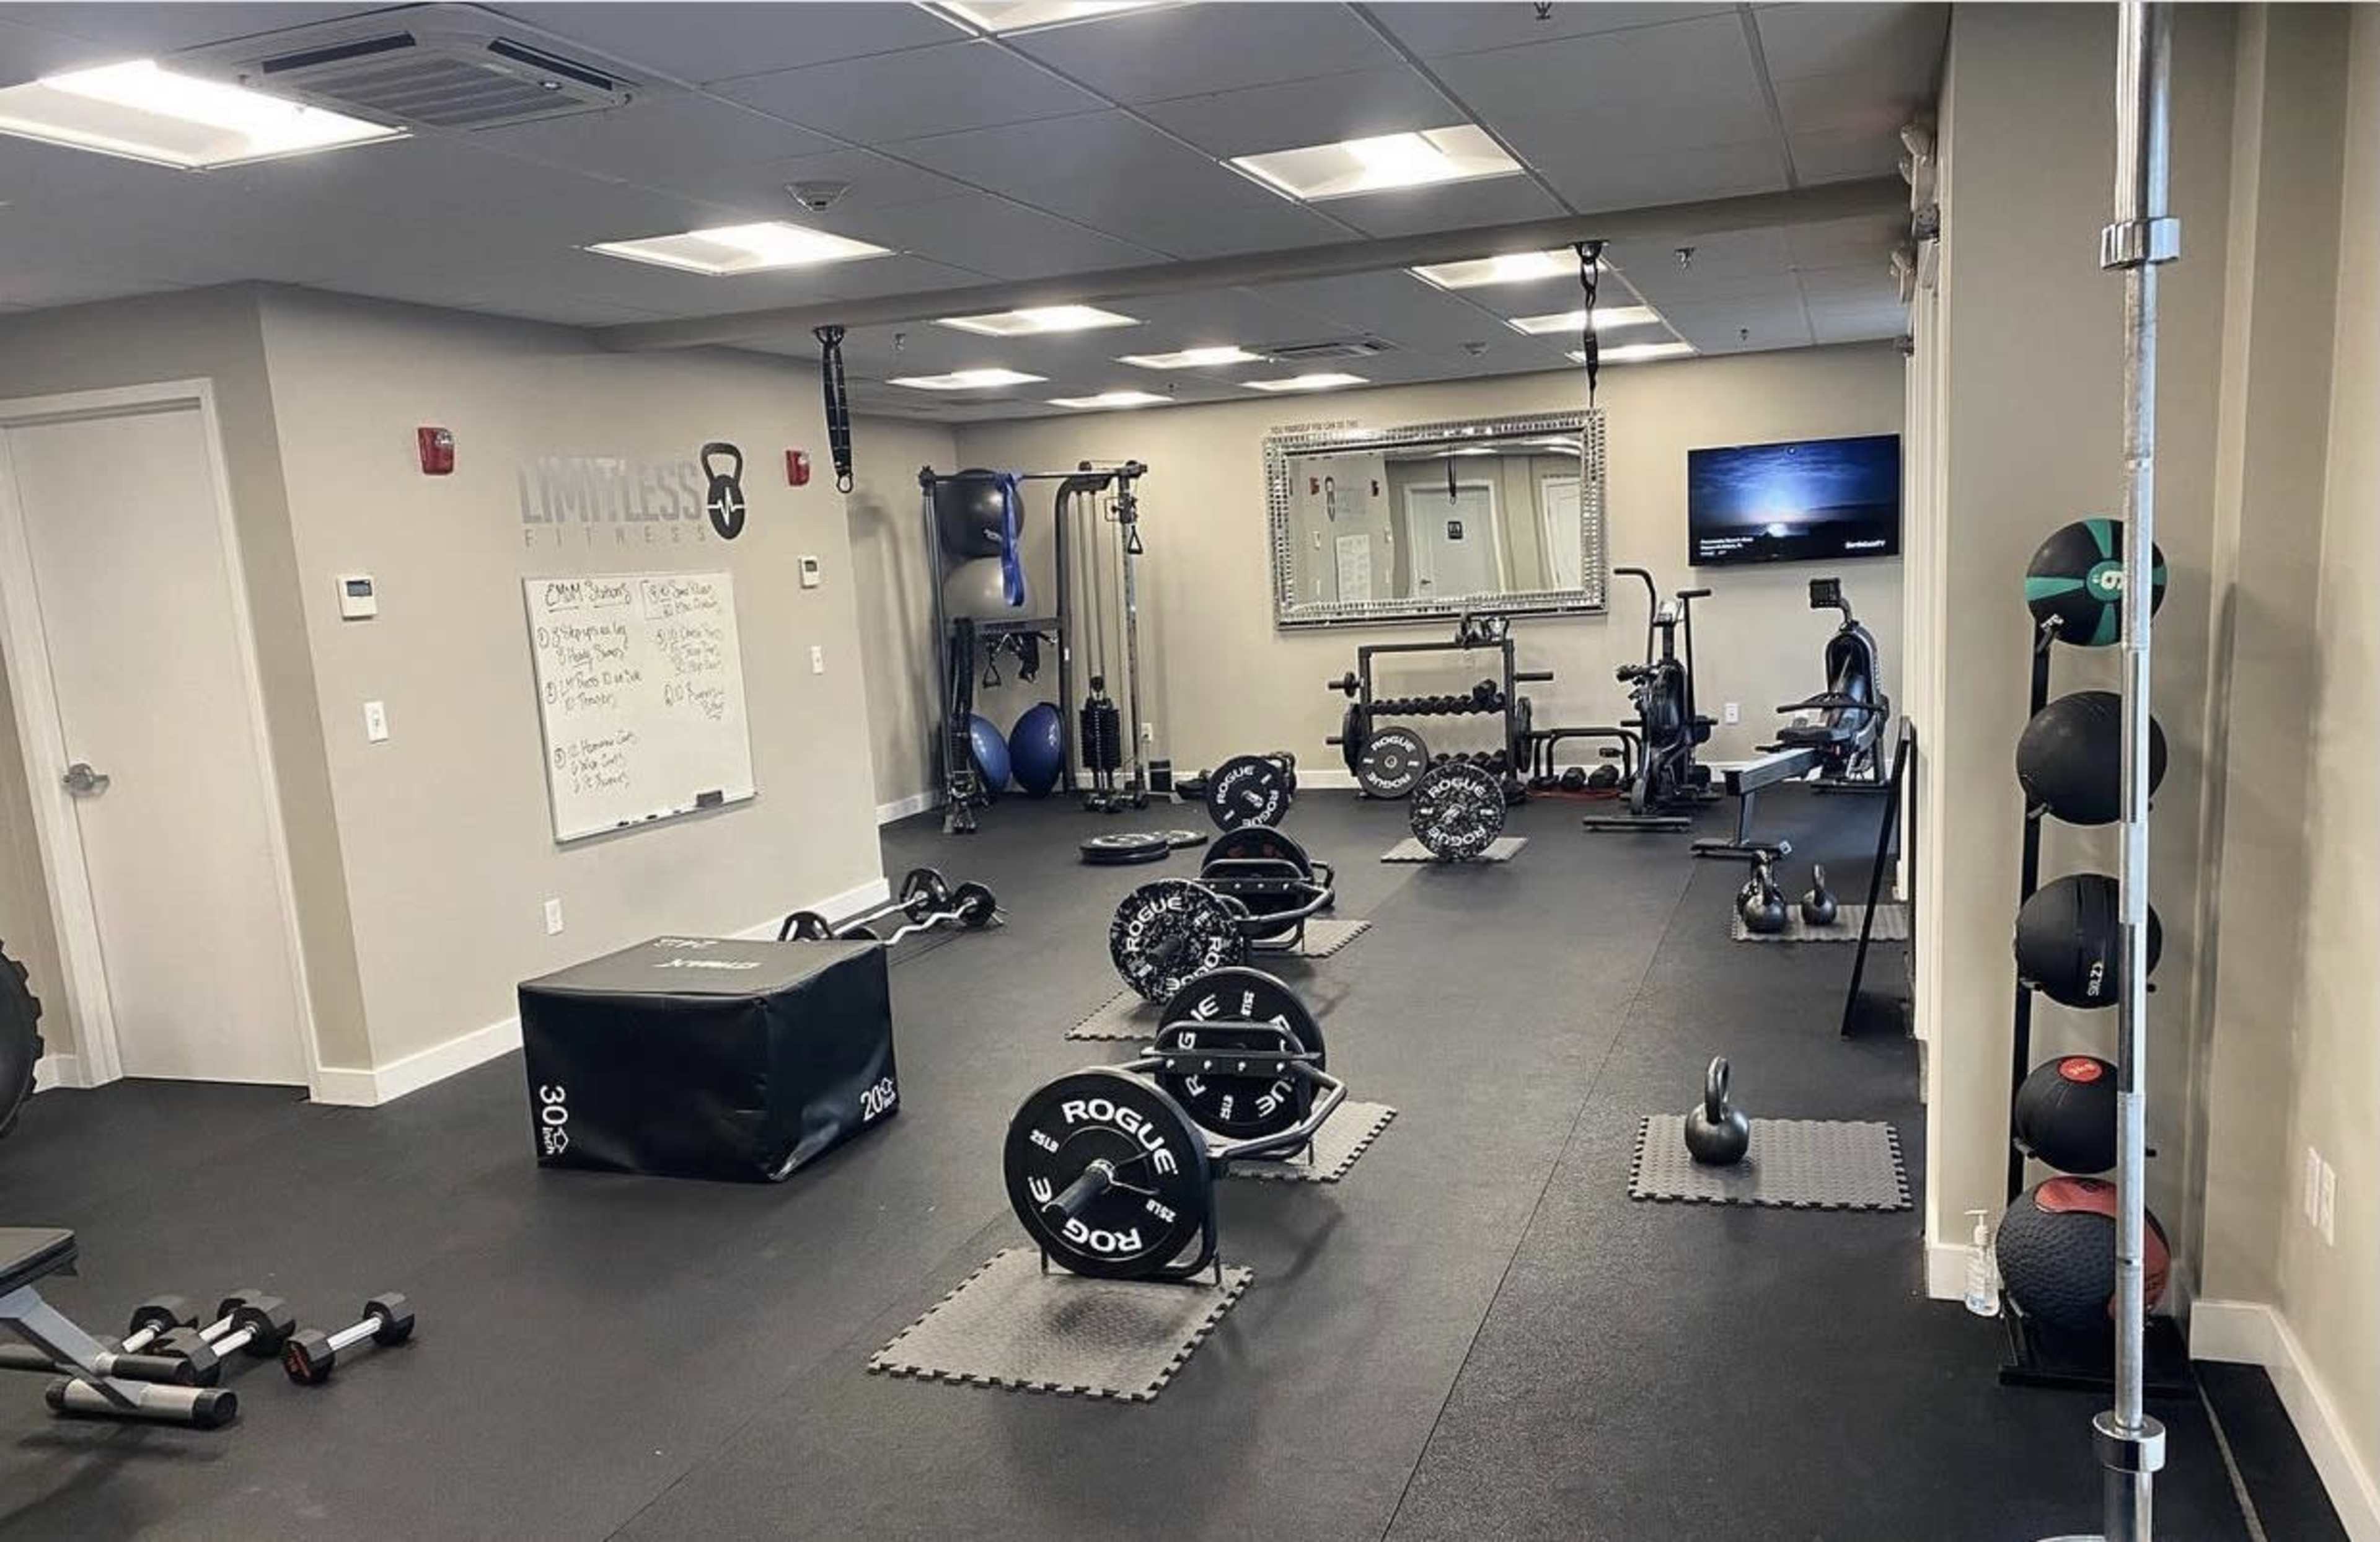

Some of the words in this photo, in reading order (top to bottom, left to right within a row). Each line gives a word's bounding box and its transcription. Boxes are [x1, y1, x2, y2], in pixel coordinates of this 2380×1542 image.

[518, 457, 702, 524] LIMITLESS
[524, 526, 706, 547] FITNESS
[1371, 736, 1416, 752] ROGUE
[1216, 765, 1256, 804] ROGUE
[1366, 772, 1411, 789] ROGUE
[1428, 777, 1486, 798] ROGUE
[1242, 790, 1280, 826] ROGUE
[1428, 825, 1486, 847] ROGUE
[1126, 897, 1183, 951] ROGUE
[540, 1085, 568, 1125] 30
[860, 1085, 883, 1122] 20
[1029, 1129, 1059, 1153] 25LB
[1062, 1098, 1176, 1174] ROGUE
[1027, 1176, 1142, 1253] ROGE
[1146, 1198, 1176, 1223] 25LB
